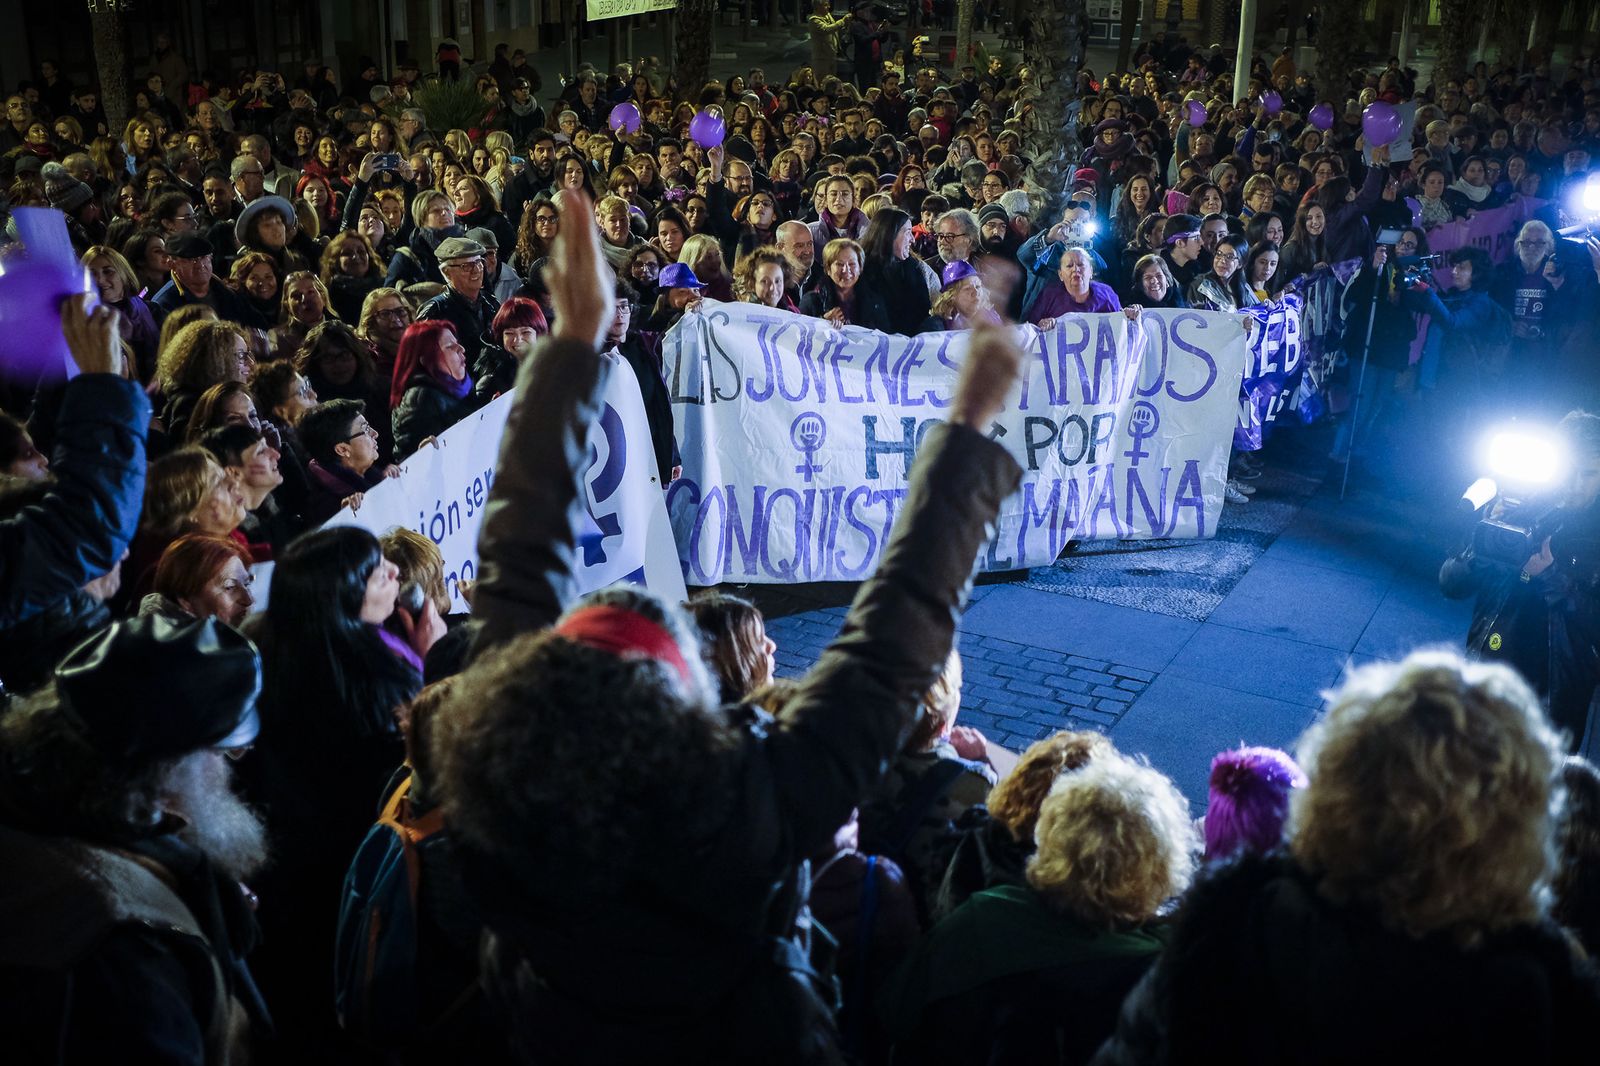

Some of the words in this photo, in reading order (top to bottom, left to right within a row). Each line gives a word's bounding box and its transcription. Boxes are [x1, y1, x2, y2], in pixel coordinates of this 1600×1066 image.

[671, 311, 741, 405] LAS
[746, 315, 960, 408] JOVENES
[1018, 311, 1217, 410] ARAMOS
[413, 500, 461, 545] ión
[666, 478, 912, 586] CONQUIST
